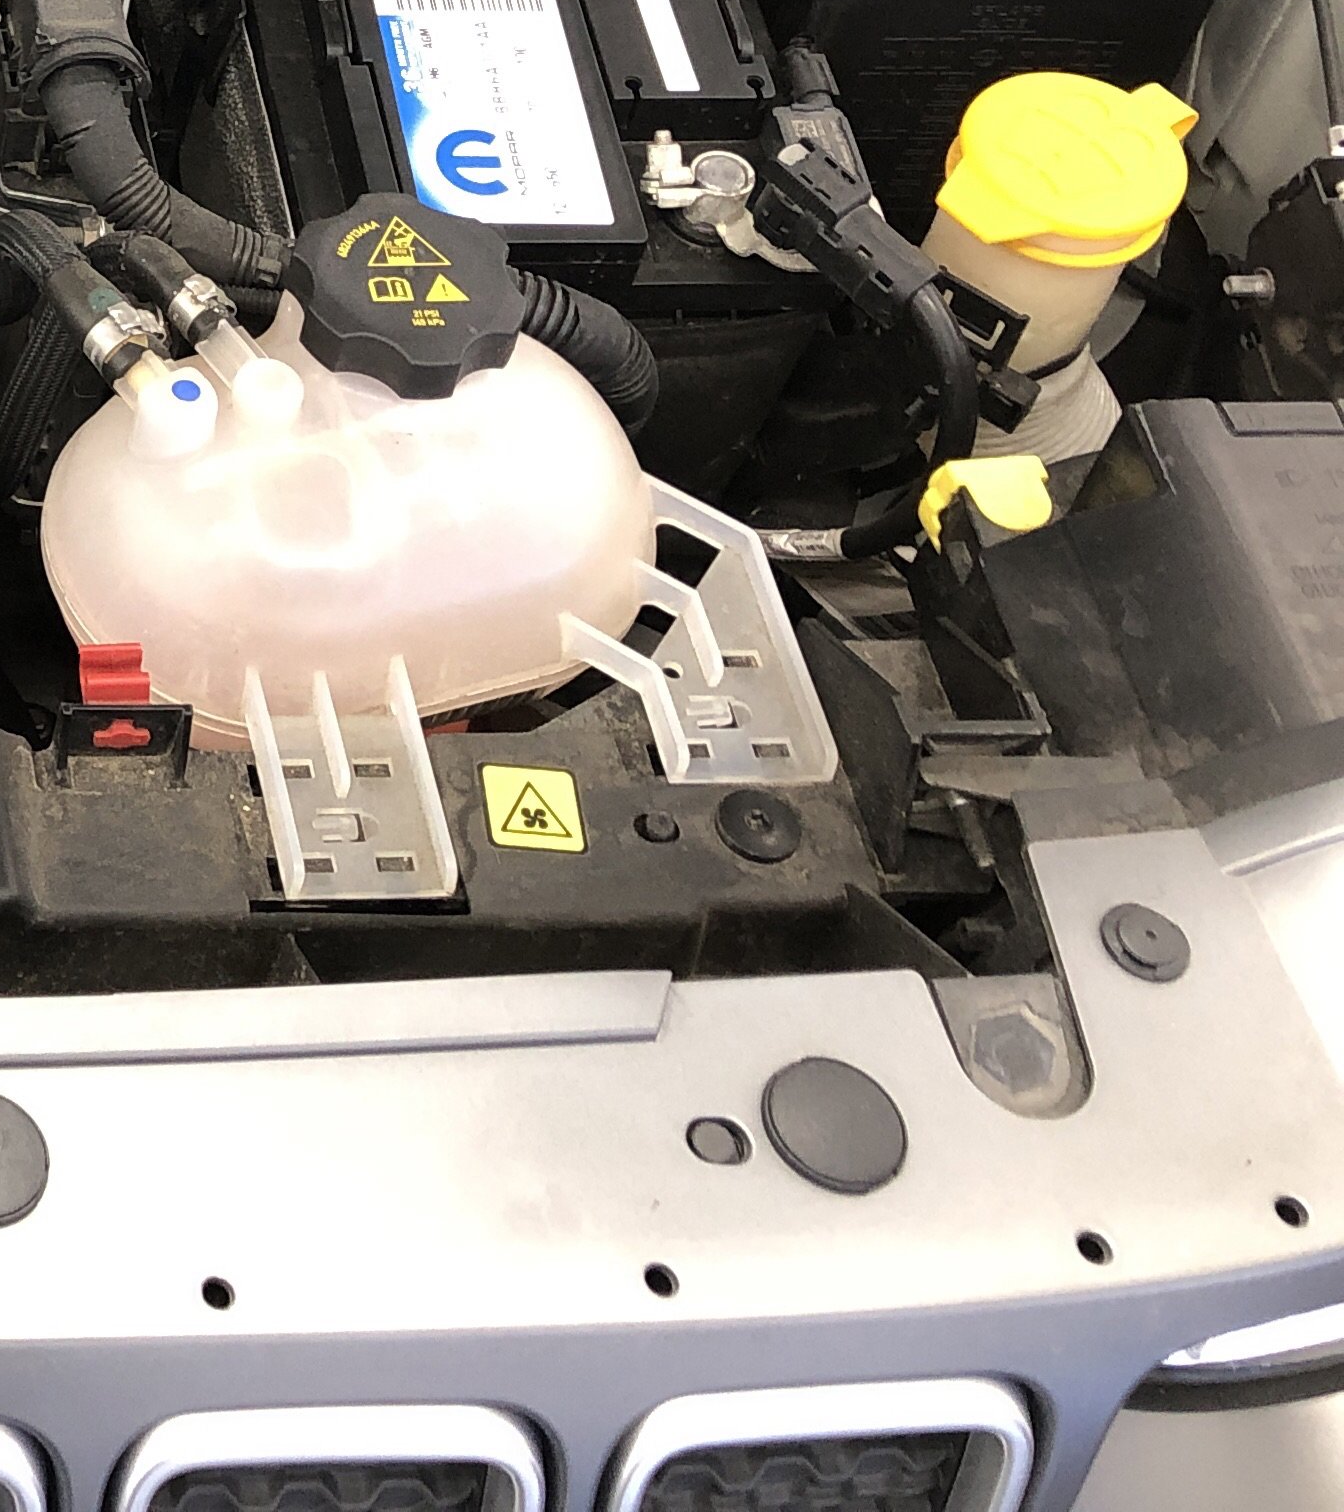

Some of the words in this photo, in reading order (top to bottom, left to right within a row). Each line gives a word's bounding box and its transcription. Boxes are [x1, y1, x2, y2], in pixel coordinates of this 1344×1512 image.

[419, 28, 433, 49] AGM
[505, 130, 528, 197] MOPAR
[423, 309, 440, 318] PSI
